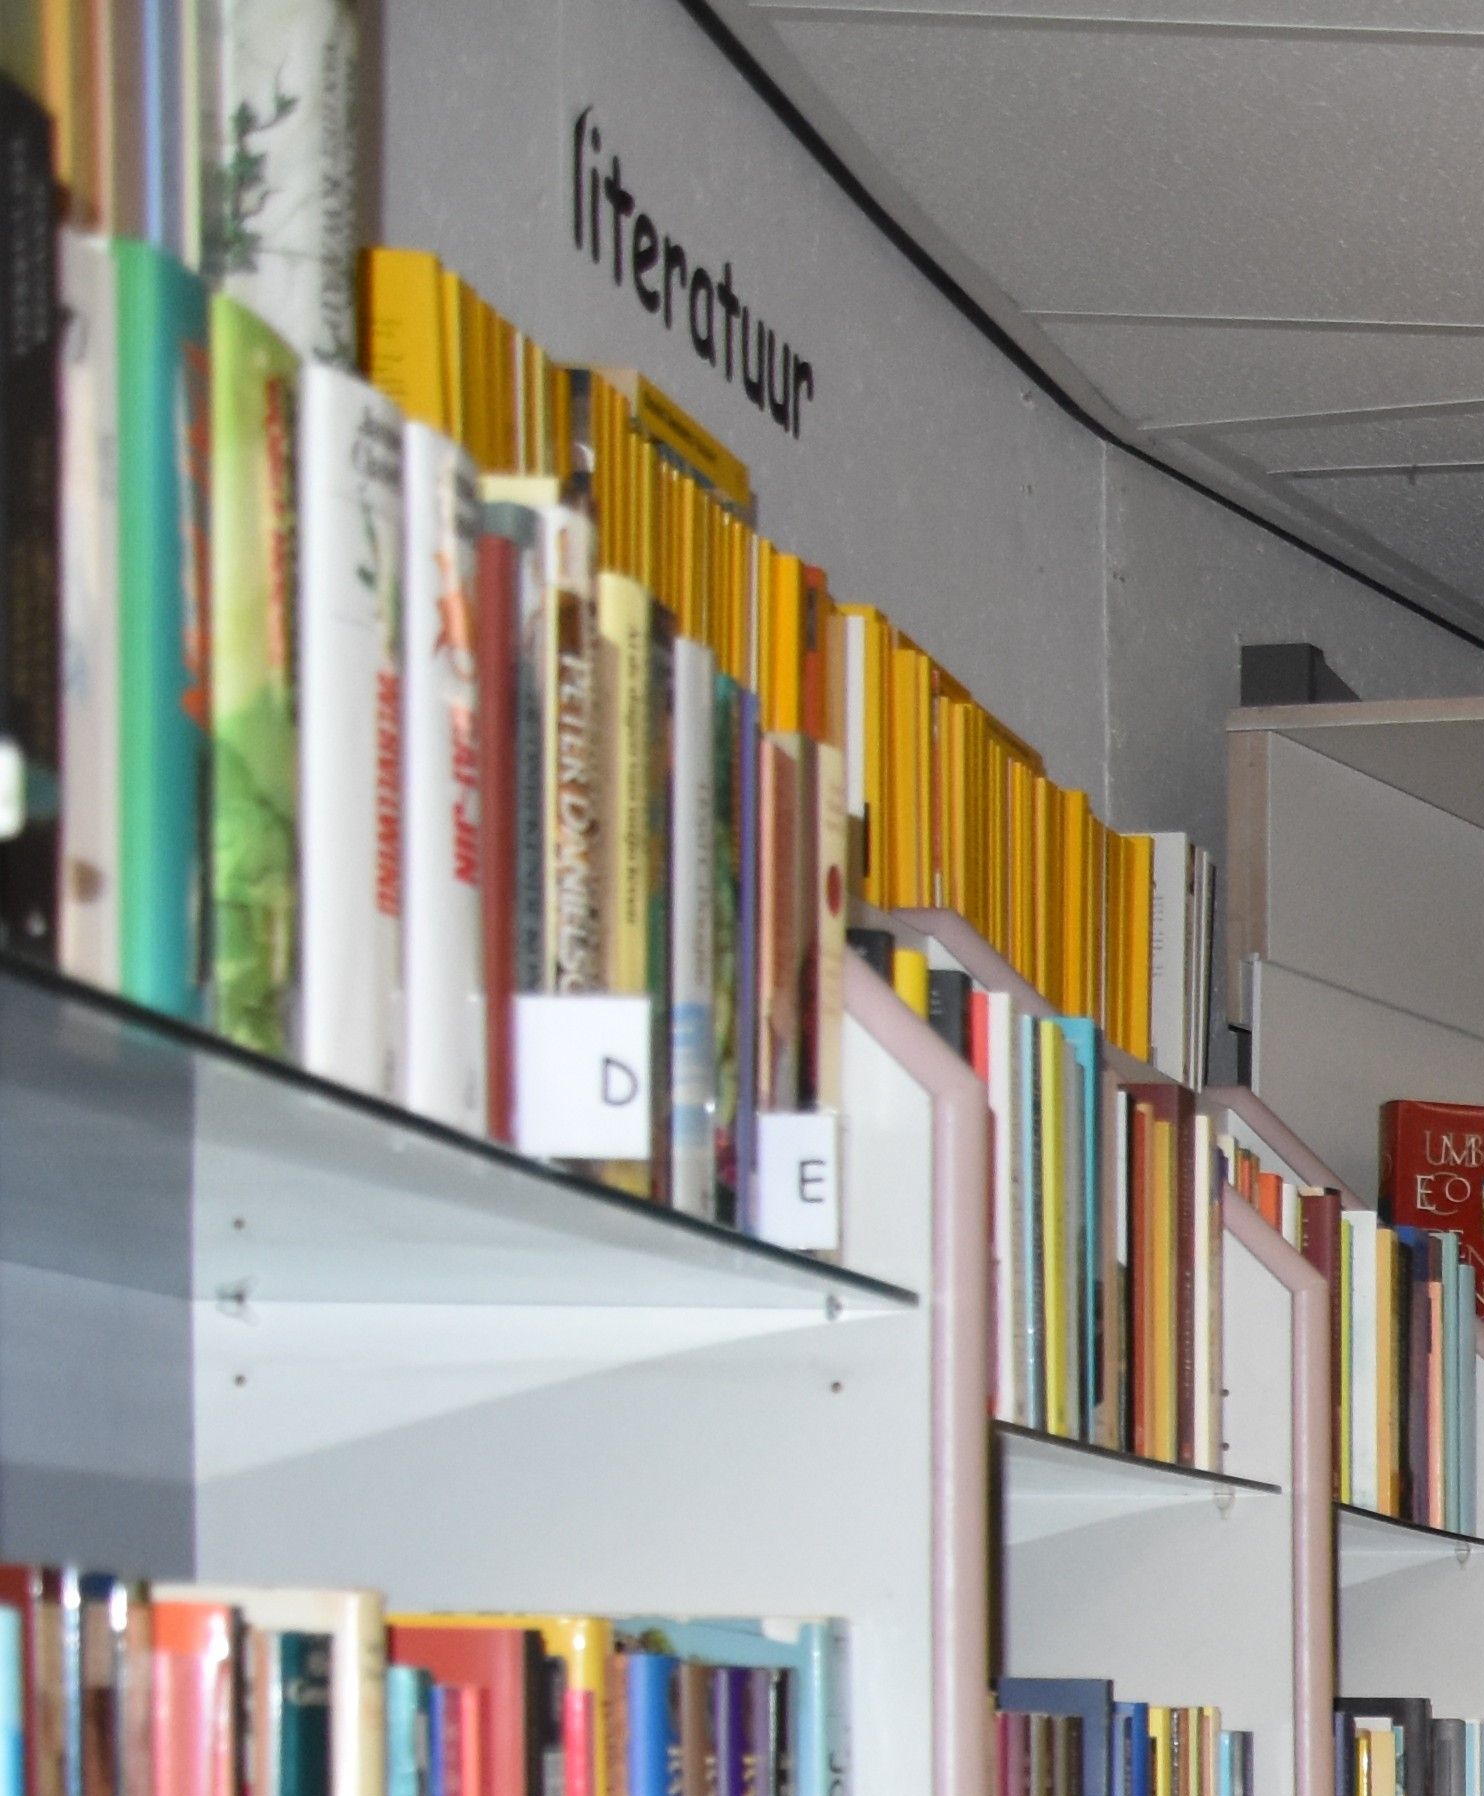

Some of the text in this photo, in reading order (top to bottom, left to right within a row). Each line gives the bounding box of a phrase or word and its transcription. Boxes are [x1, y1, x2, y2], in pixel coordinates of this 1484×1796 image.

[573, 105, 814, 440] literatuur
[600, 1057, 640, 1107] D
[798, 1161, 825, 1203] E
